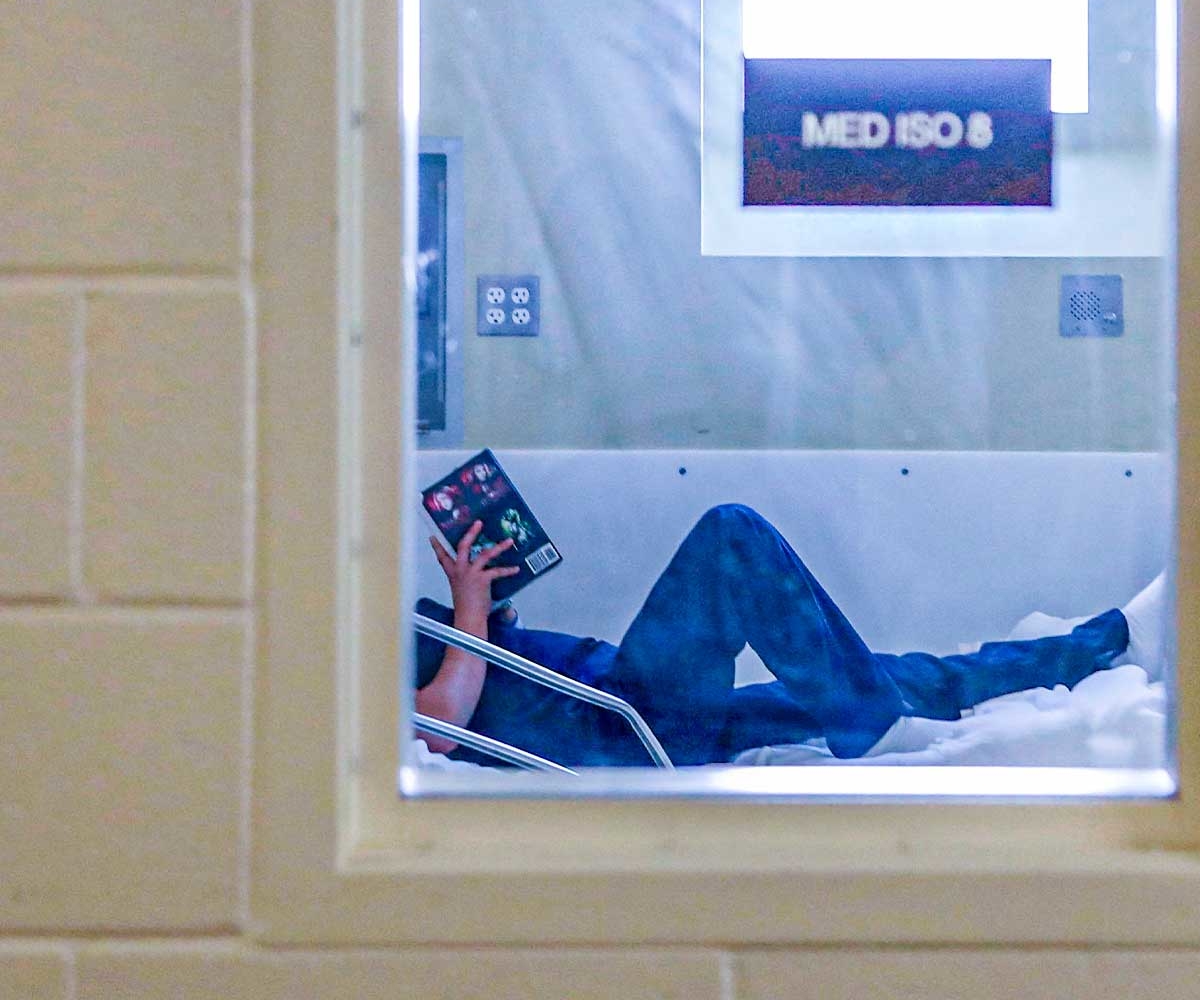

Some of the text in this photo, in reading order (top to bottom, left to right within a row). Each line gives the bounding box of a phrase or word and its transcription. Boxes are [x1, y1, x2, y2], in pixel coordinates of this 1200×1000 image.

[801, 111, 994, 150] MED ISO 8
